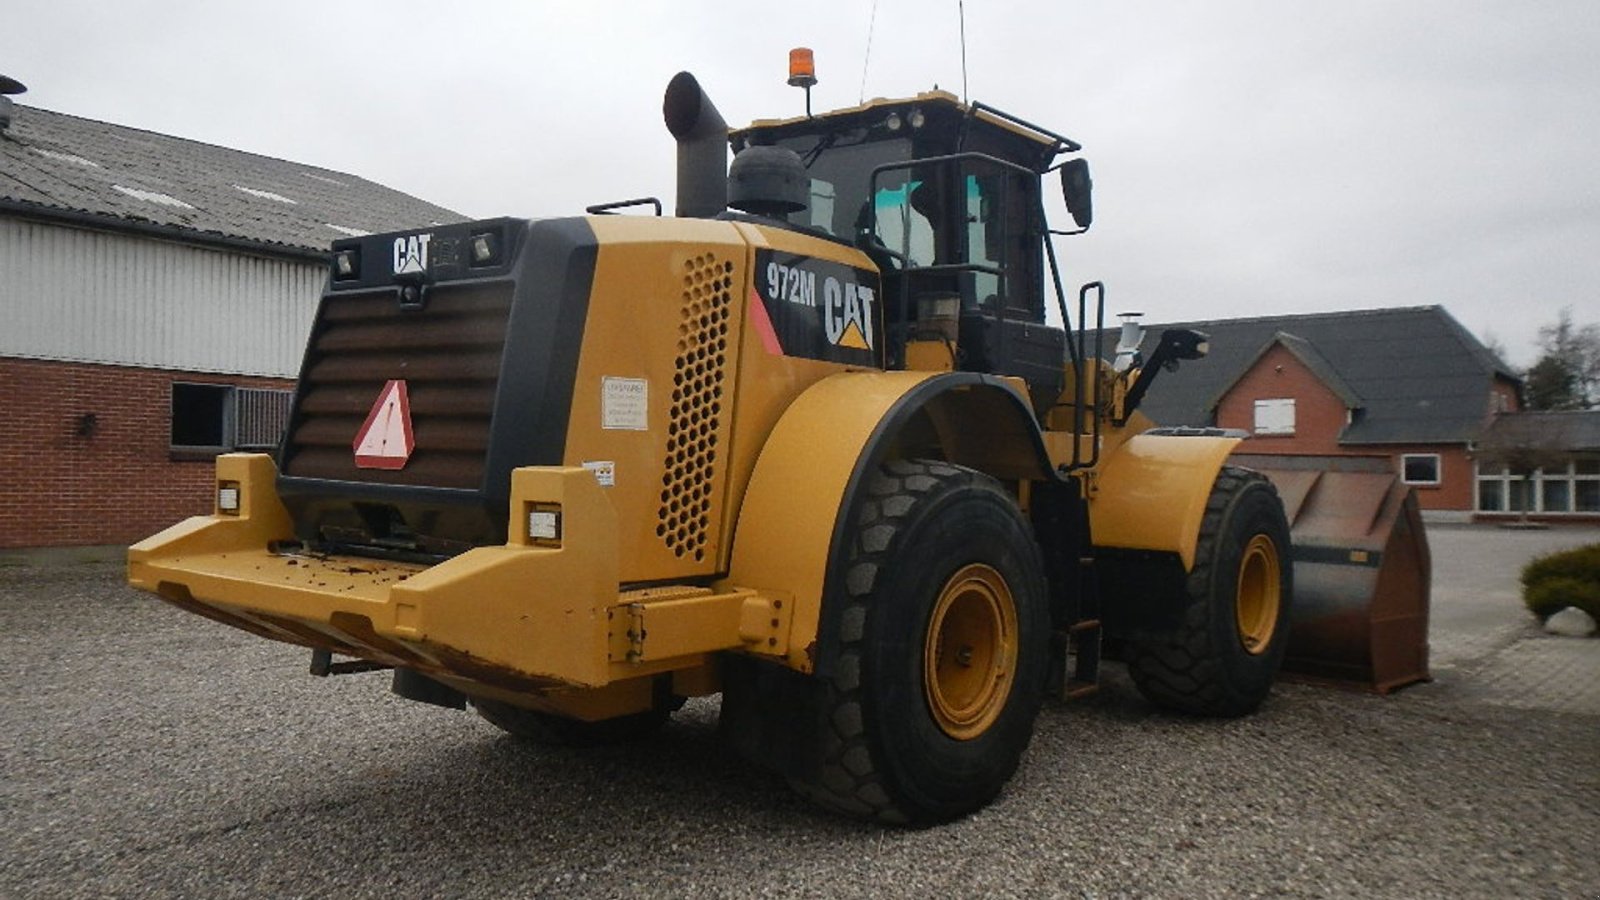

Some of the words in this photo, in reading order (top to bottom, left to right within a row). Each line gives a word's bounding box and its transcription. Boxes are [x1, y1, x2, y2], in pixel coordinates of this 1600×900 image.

[394, 234, 431, 274] CAT
[767, 262, 816, 307] 972M
[824, 276, 874, 351] CAT
